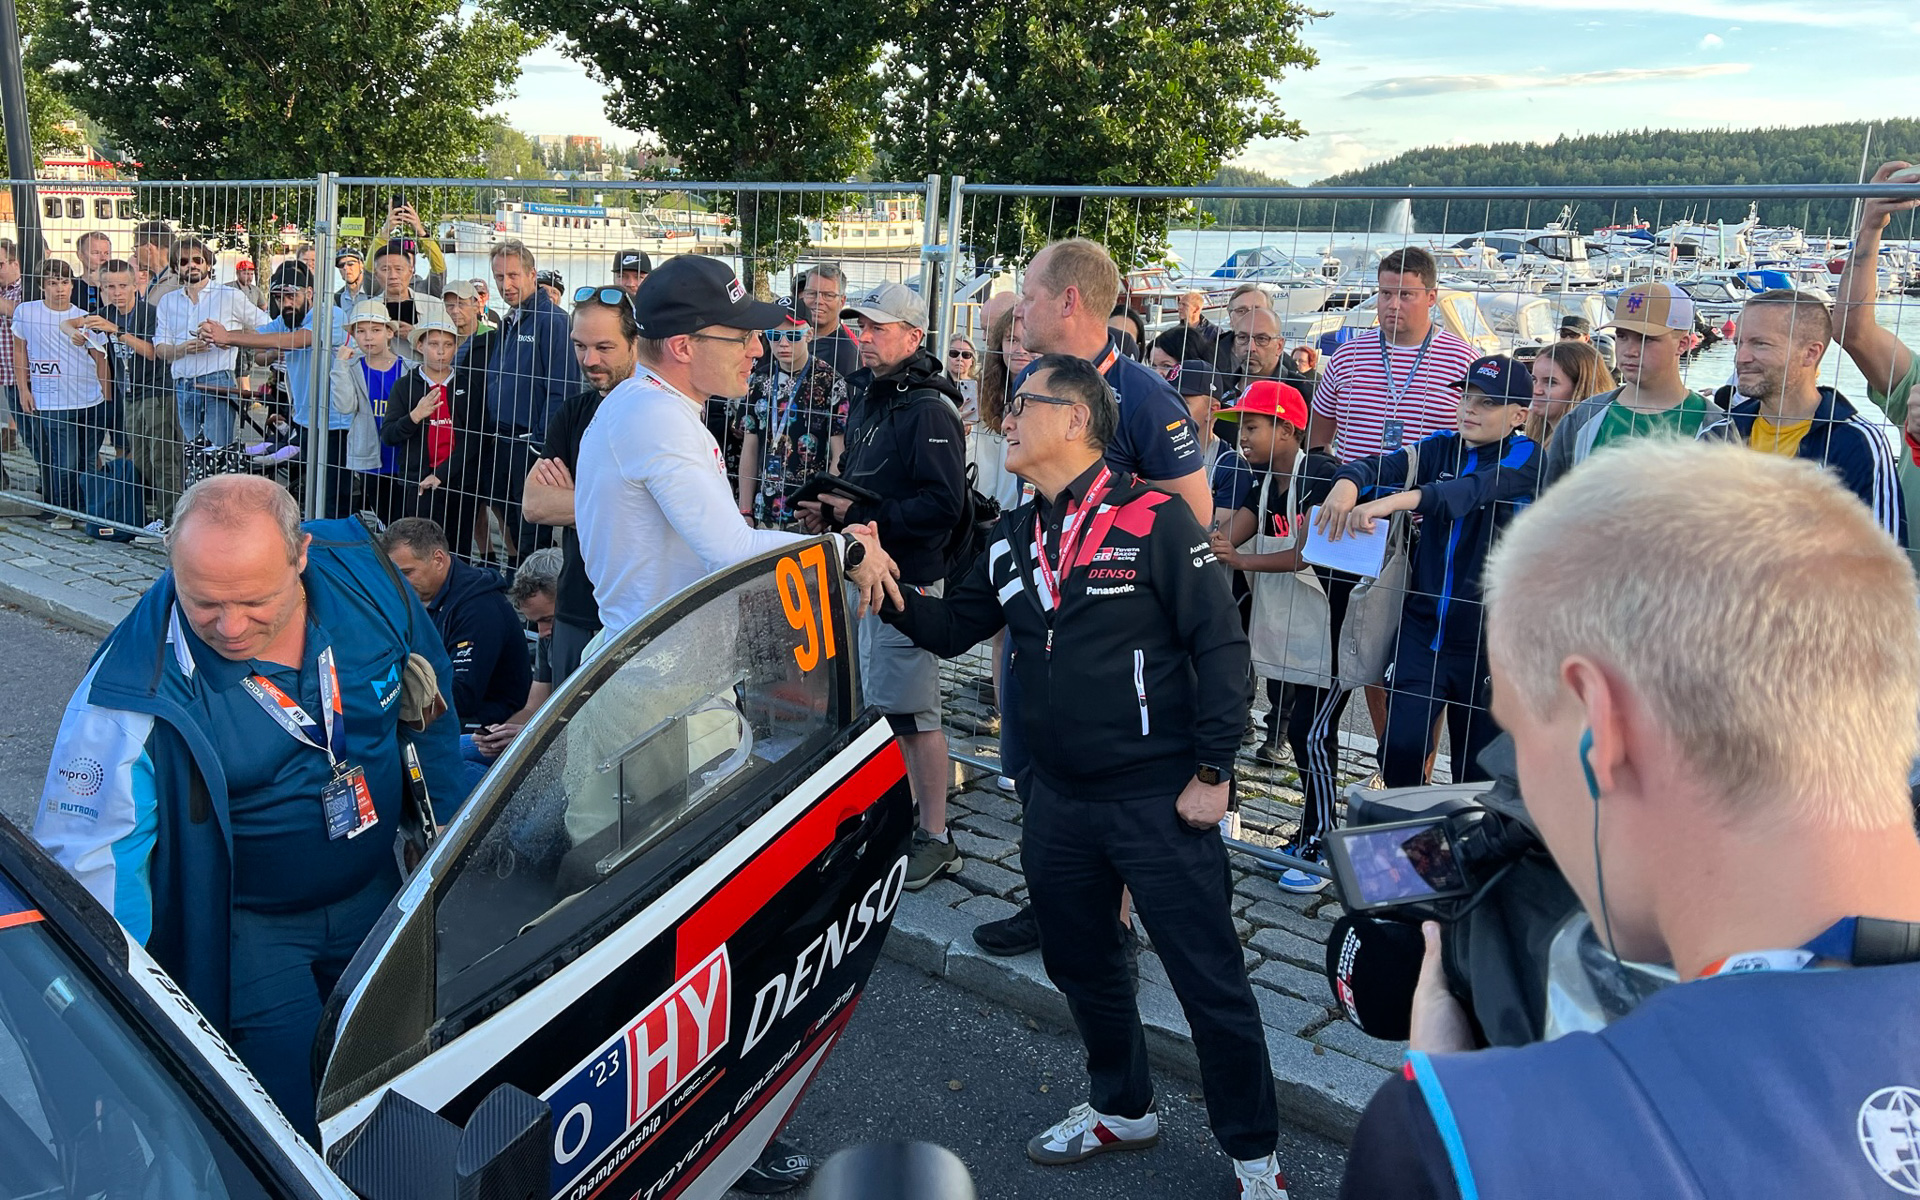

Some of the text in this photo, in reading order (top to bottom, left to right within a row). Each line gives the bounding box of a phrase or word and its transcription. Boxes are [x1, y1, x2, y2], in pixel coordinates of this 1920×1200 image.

[1086, 583, 1135, 595] Panasonic
[1088, 569, 1137, 580] DENSO
[775, 544, 836, 672] 97
[58, 768, 88, 781] wipro
[740, 855, 908, 1059] DENSO
[1338, 926, 1355, 974] TOYOTA
[1341, 933, 1357, 981] GAZOO
[634, 958, 724, 1119] HY
[589, 1049, 620, 1088] '23
[643, 982, 856, 1200] TOYOTA GAZOO Racing
[554, 1102, 593, 1165] O
